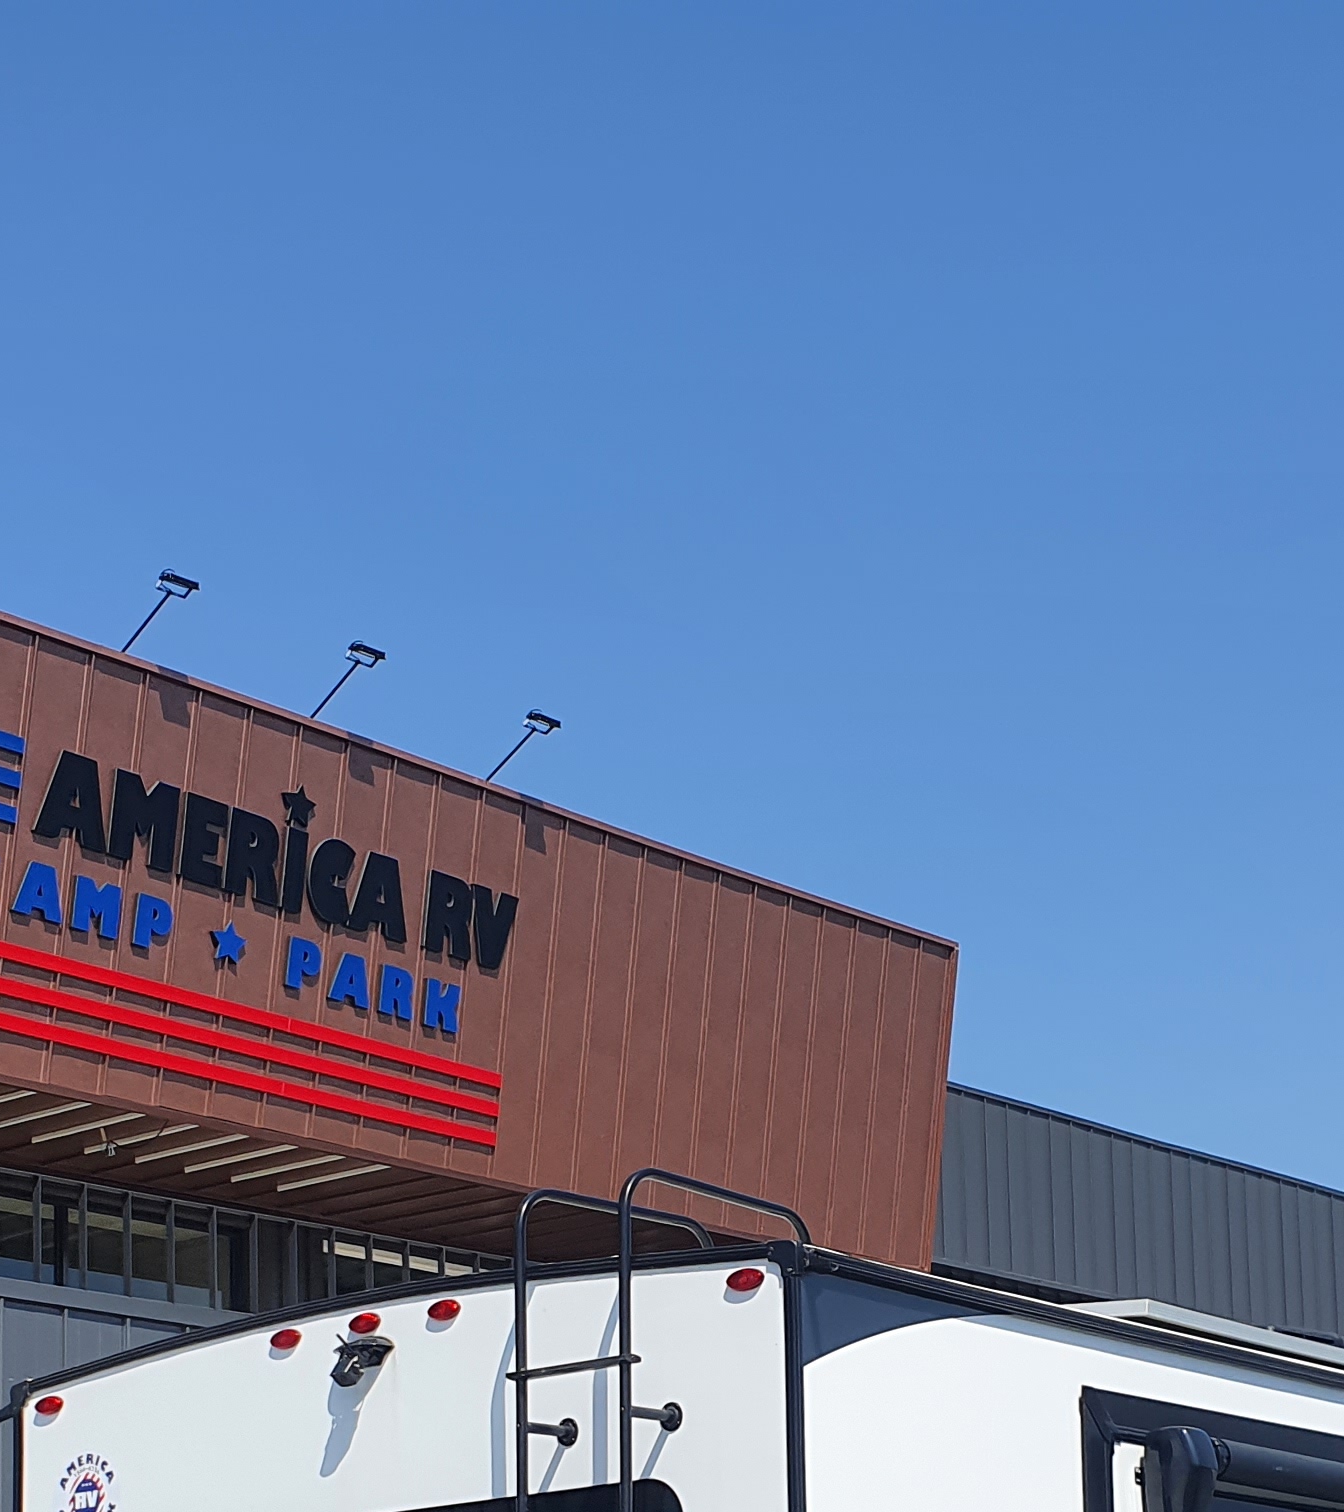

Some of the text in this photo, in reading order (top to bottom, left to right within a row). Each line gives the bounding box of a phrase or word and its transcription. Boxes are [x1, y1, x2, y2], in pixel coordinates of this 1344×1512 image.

[421, 869, 519, 970] RV
[283, 935, 462, 1034] PARK
[60, 1453, 115, 1491] AMERICA
[75, 1490, 99, 1510] RV
